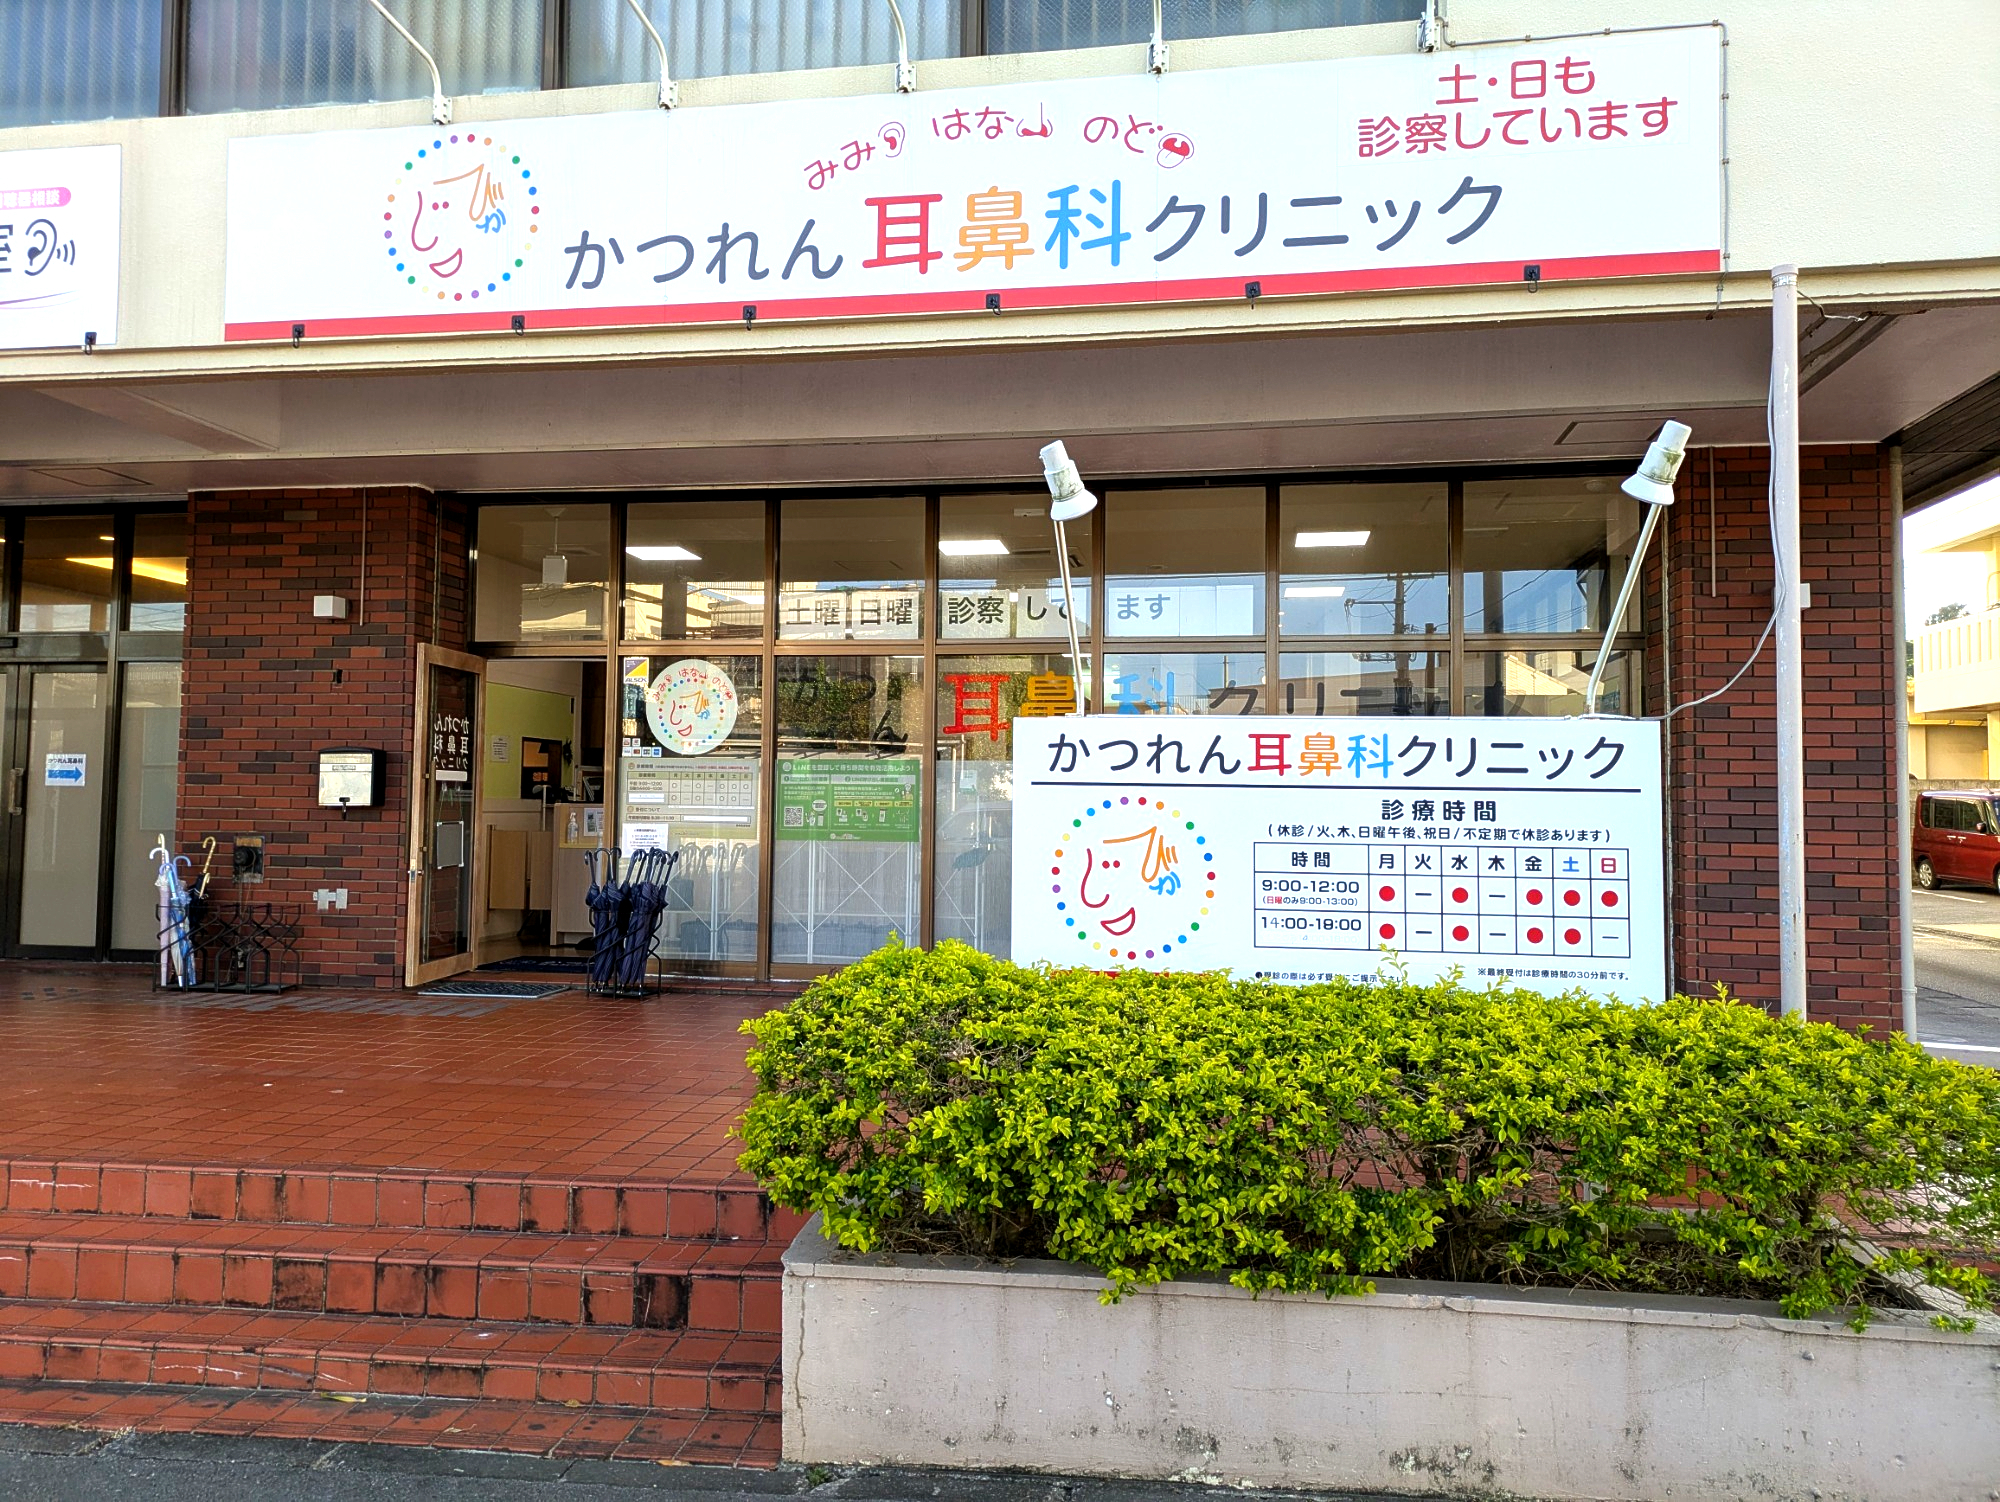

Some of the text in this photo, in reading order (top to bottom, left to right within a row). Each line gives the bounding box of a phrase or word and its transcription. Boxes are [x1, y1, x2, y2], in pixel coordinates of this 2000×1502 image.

[1436, 55, 1595, 105] 土・日も
[1358, 96, 1679, 158] 診察しています
[804, 106, 1163, 191] みみ はな のど
[565, 176, 1503, 290] かつれん耳鼻科クリニック
[1048, 732, 1626, 781] かつれん耳鼻科クリニック
[1381, 799, 1497, 822] 診療時間
[1291, 851, 1617, 874] 時間 月 火 水 木 金 土 日
[1261, 879, 1360, 894] 9:00-12:00
[1262, 895, 1358, 907] (日曜のみ9:00-13:00)
[1261, 916, 1362, 932] 14:00-18:00
